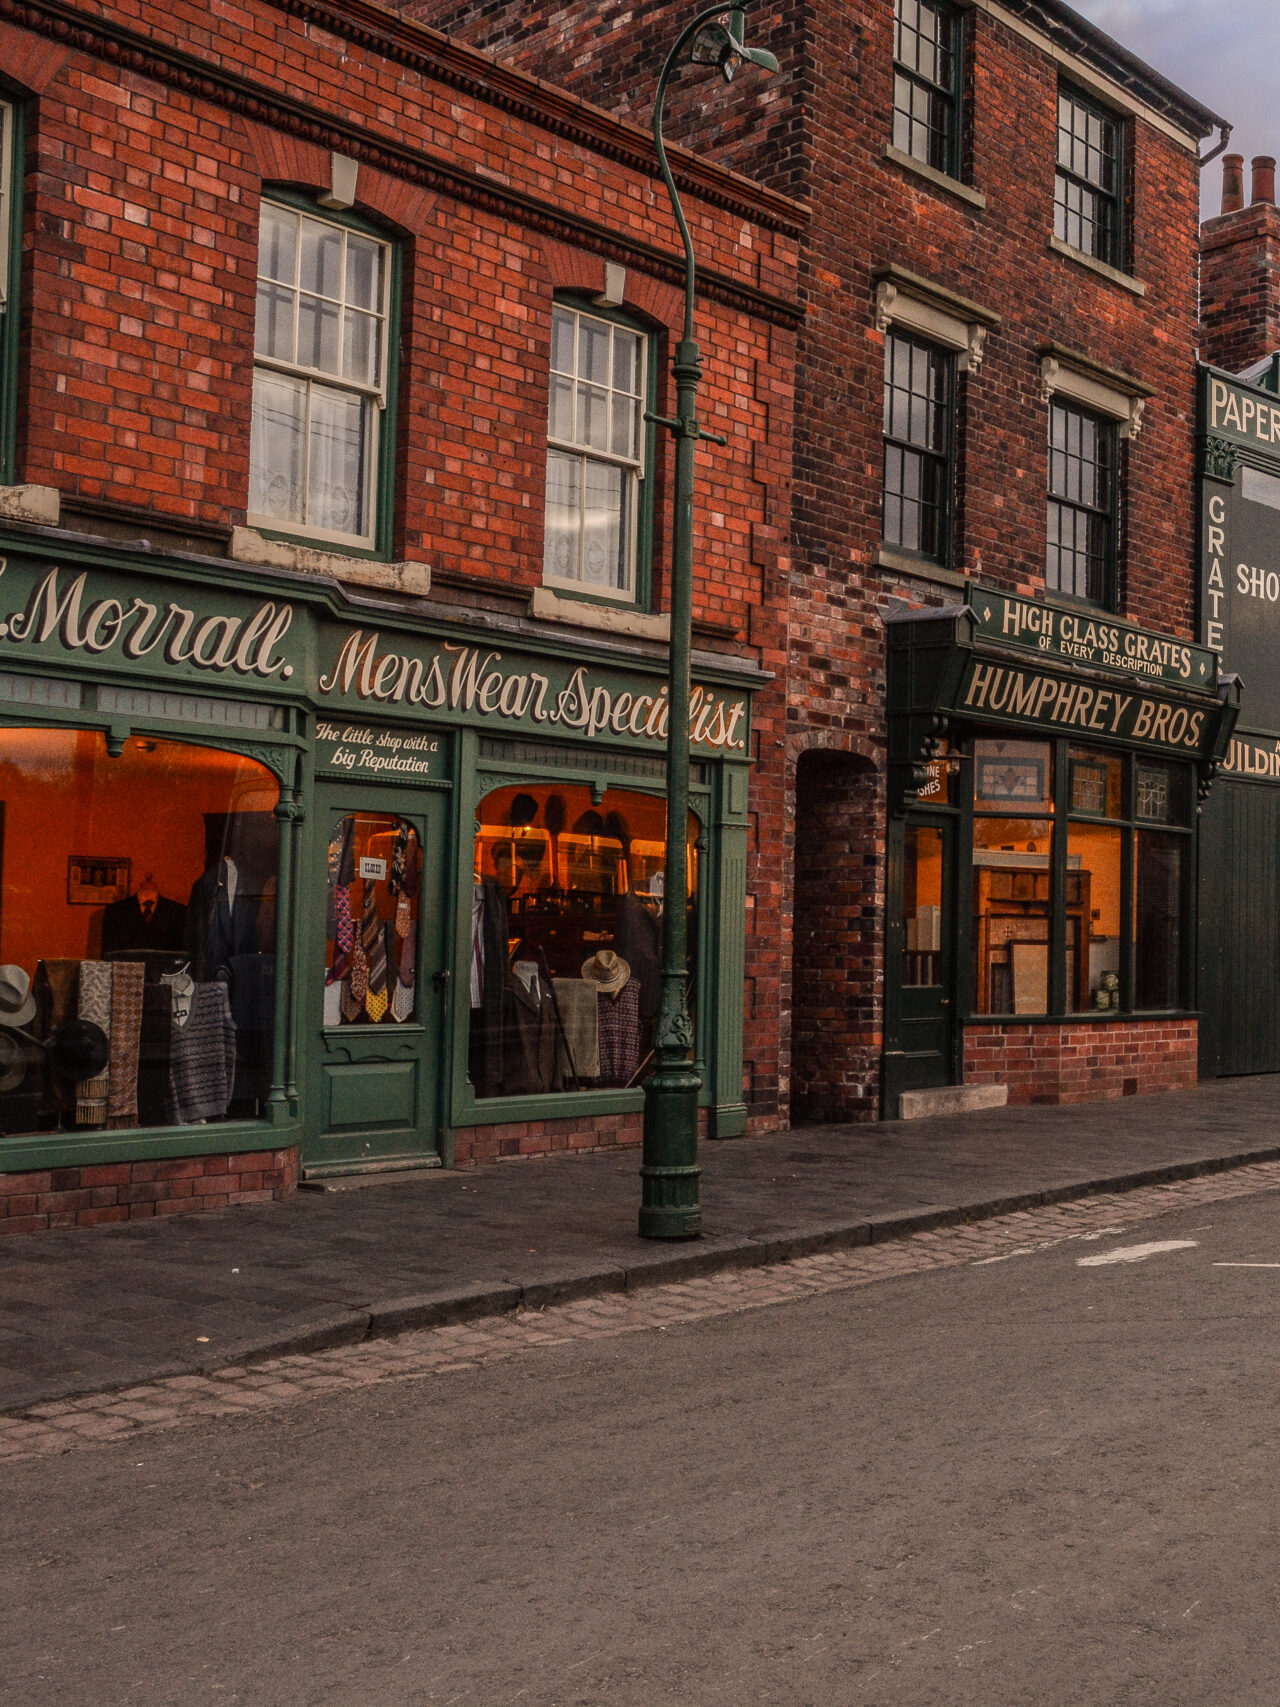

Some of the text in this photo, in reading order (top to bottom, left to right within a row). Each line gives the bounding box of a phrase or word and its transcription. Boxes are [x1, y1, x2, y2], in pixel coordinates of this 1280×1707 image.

[10, 565, 294, 677] Morrall.
[1002, 599, 1192, 678] HIGH CLASS GRATES
[1038, 635, 1163, 678] OF EVERY DESCRIPTION
[965, 663, 1205, 748] HUMPHREY BROS.
[315, 723, 438, 753] The little shop with a
[330, 746, 429, 773] big Reputation
[923, 764, 940, 778] INE
